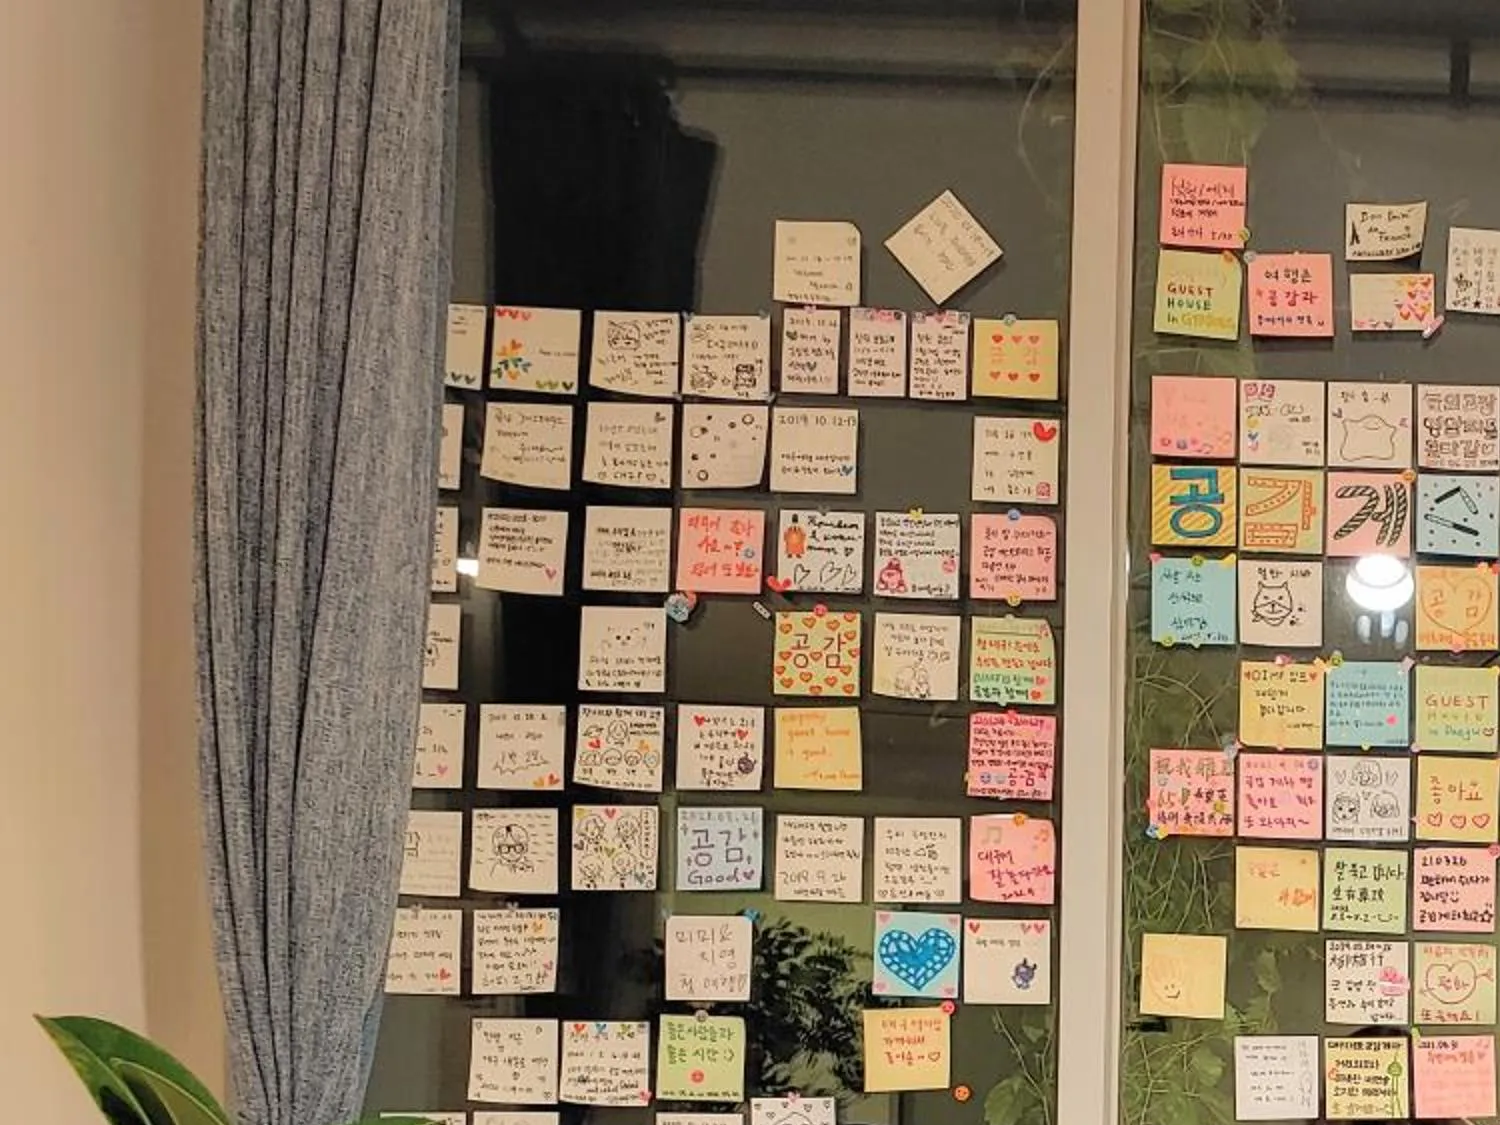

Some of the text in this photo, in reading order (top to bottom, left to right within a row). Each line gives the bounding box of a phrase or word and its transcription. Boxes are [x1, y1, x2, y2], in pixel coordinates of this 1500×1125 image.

[1168, 284, 1214, 298] GUEST
[1168, 298, 1212, 311] HOUSE
[790, 632, 848, 670] 공감
[1425, 694, 1489, 711] GUEST
[689, 828, 749, 868] 공감
[687, 869, 740, 886] Good
